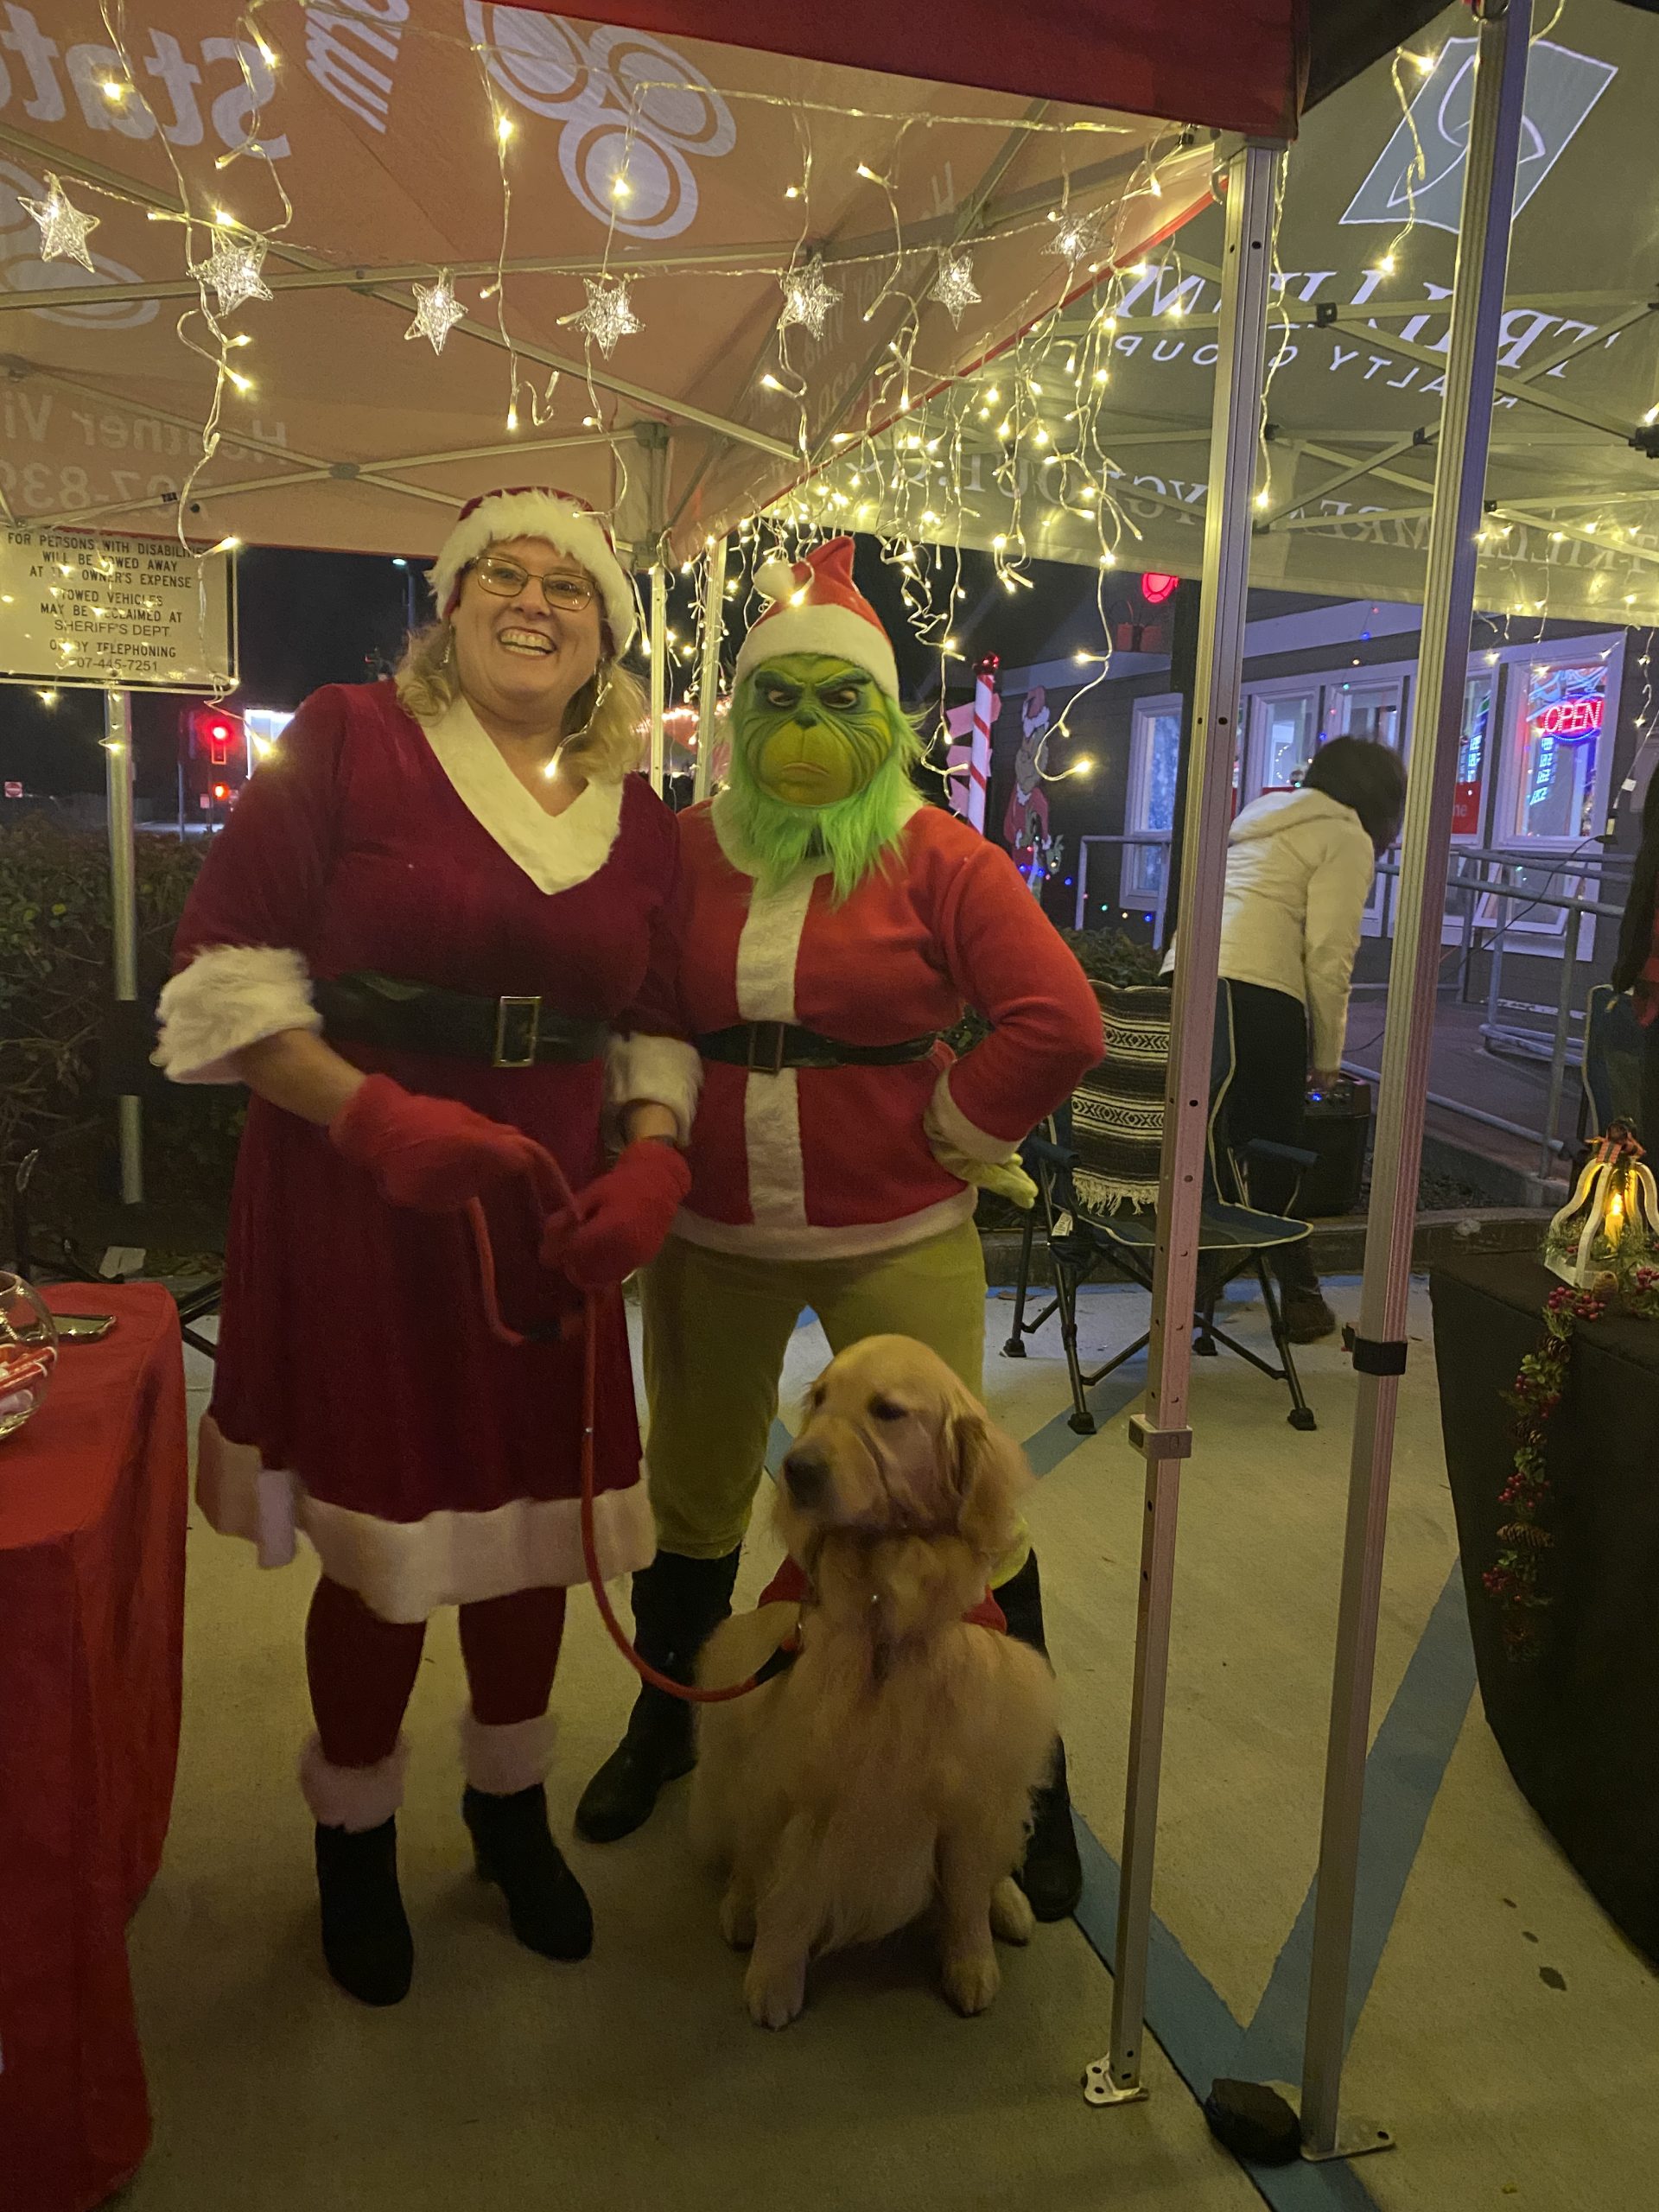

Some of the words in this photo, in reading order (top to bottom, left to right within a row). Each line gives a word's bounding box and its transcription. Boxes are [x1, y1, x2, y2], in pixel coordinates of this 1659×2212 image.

[8, 532, 31, 545] FOR
[40, 535, 95, 550] PERSONS
[102, 540, 130, 554] WITH
[42, 550, 69, 564] WILL
[78, 554, 93, 566] BE
[147, 560, 178, 572] AWAY
[29, 566, 43, 577] AT
[140, 574, 192, 588] EXPENSE
[61, 588, 99, 602] TOWED
[107, 592, 163, 607] VEHICLES
[41, 603, 65, 614] MAY
[73, 605, 88, 617] BE
[93, 607, 162, 622] ECLAIMED
[168, 612, 183, 623] AT
[54, 620, 129, 635] SHERIFF'S
[96, 641, 177, 658] TELEPHONING
[1544, 701, 1602, 733] OPEN
